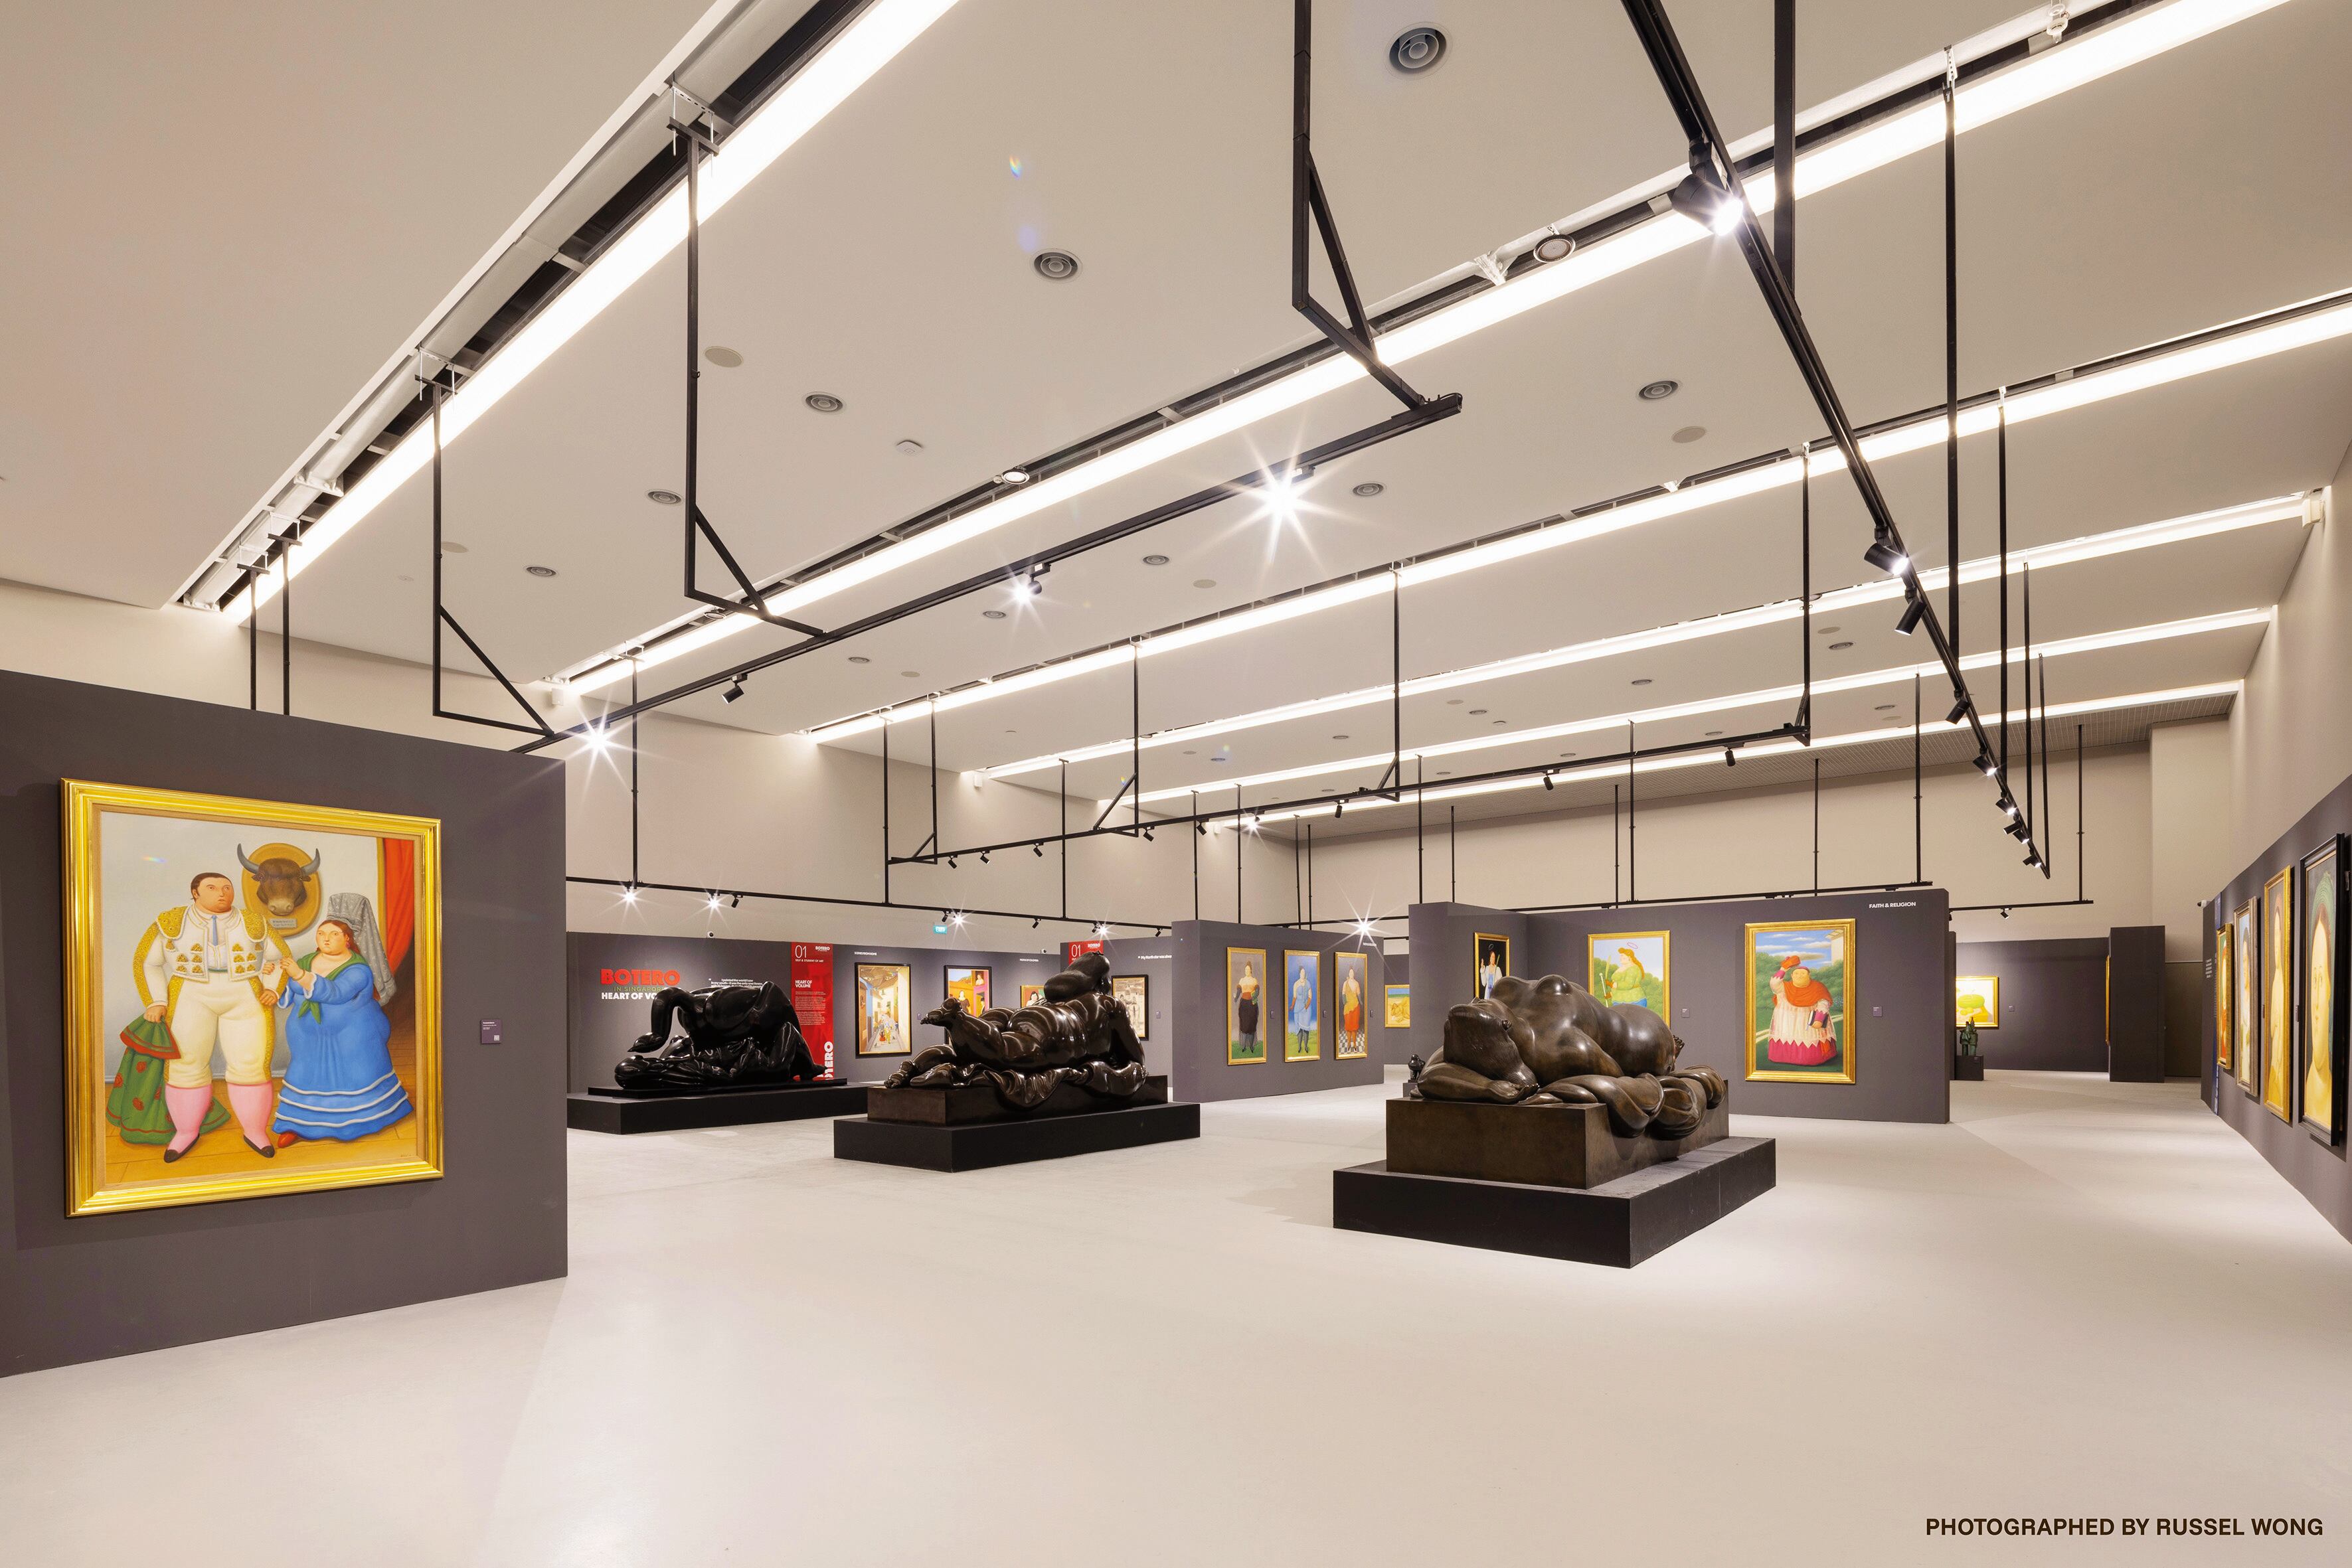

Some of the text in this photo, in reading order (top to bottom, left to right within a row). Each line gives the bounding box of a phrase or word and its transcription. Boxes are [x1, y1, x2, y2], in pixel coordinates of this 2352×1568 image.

[795, 945, 807, 958] 01
[1071, 944, 1081, 957] 01
[600, 969, 681, 986] BOTERO
